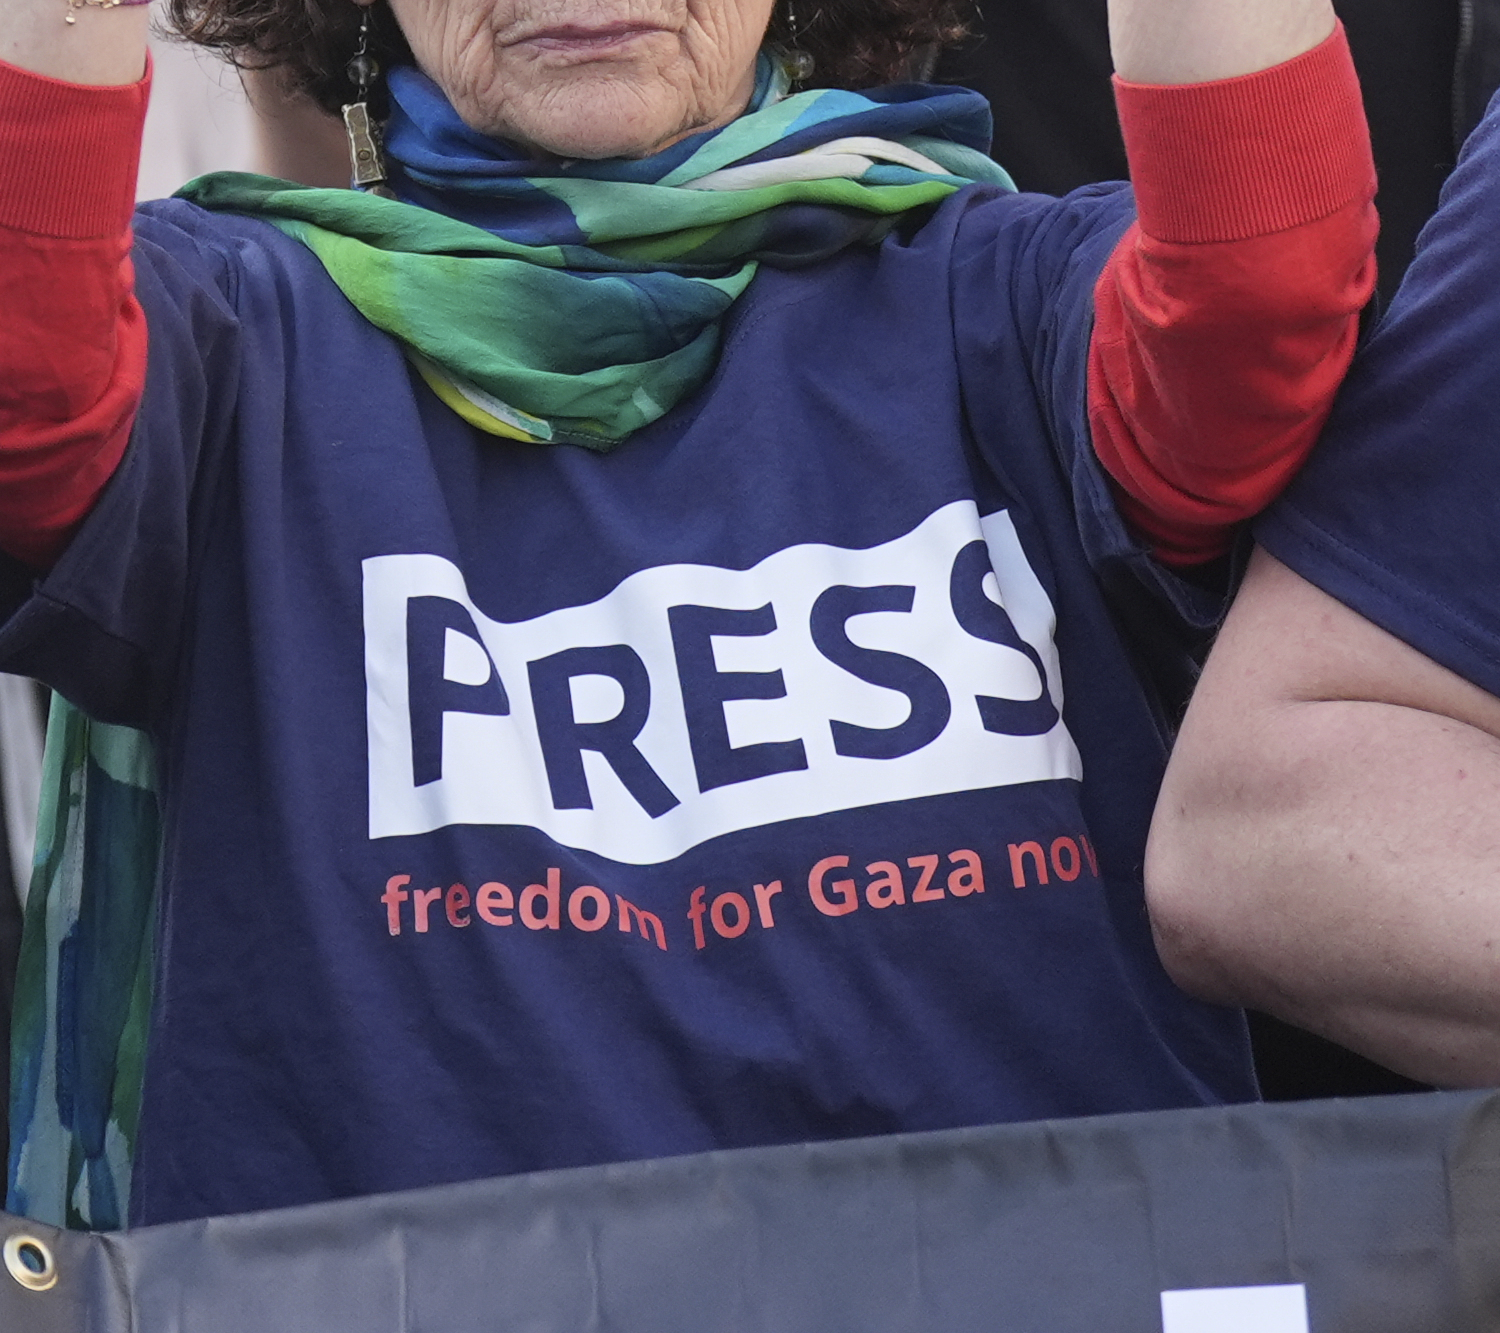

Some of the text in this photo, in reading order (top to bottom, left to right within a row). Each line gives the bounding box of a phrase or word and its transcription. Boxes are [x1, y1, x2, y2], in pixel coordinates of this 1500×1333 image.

[405, 539, 1060, 820] PRESS
[380, 868, 668, 952] freedom
[687, 876, 783, 951] for
[807, 846, 987, 917] Gaza
